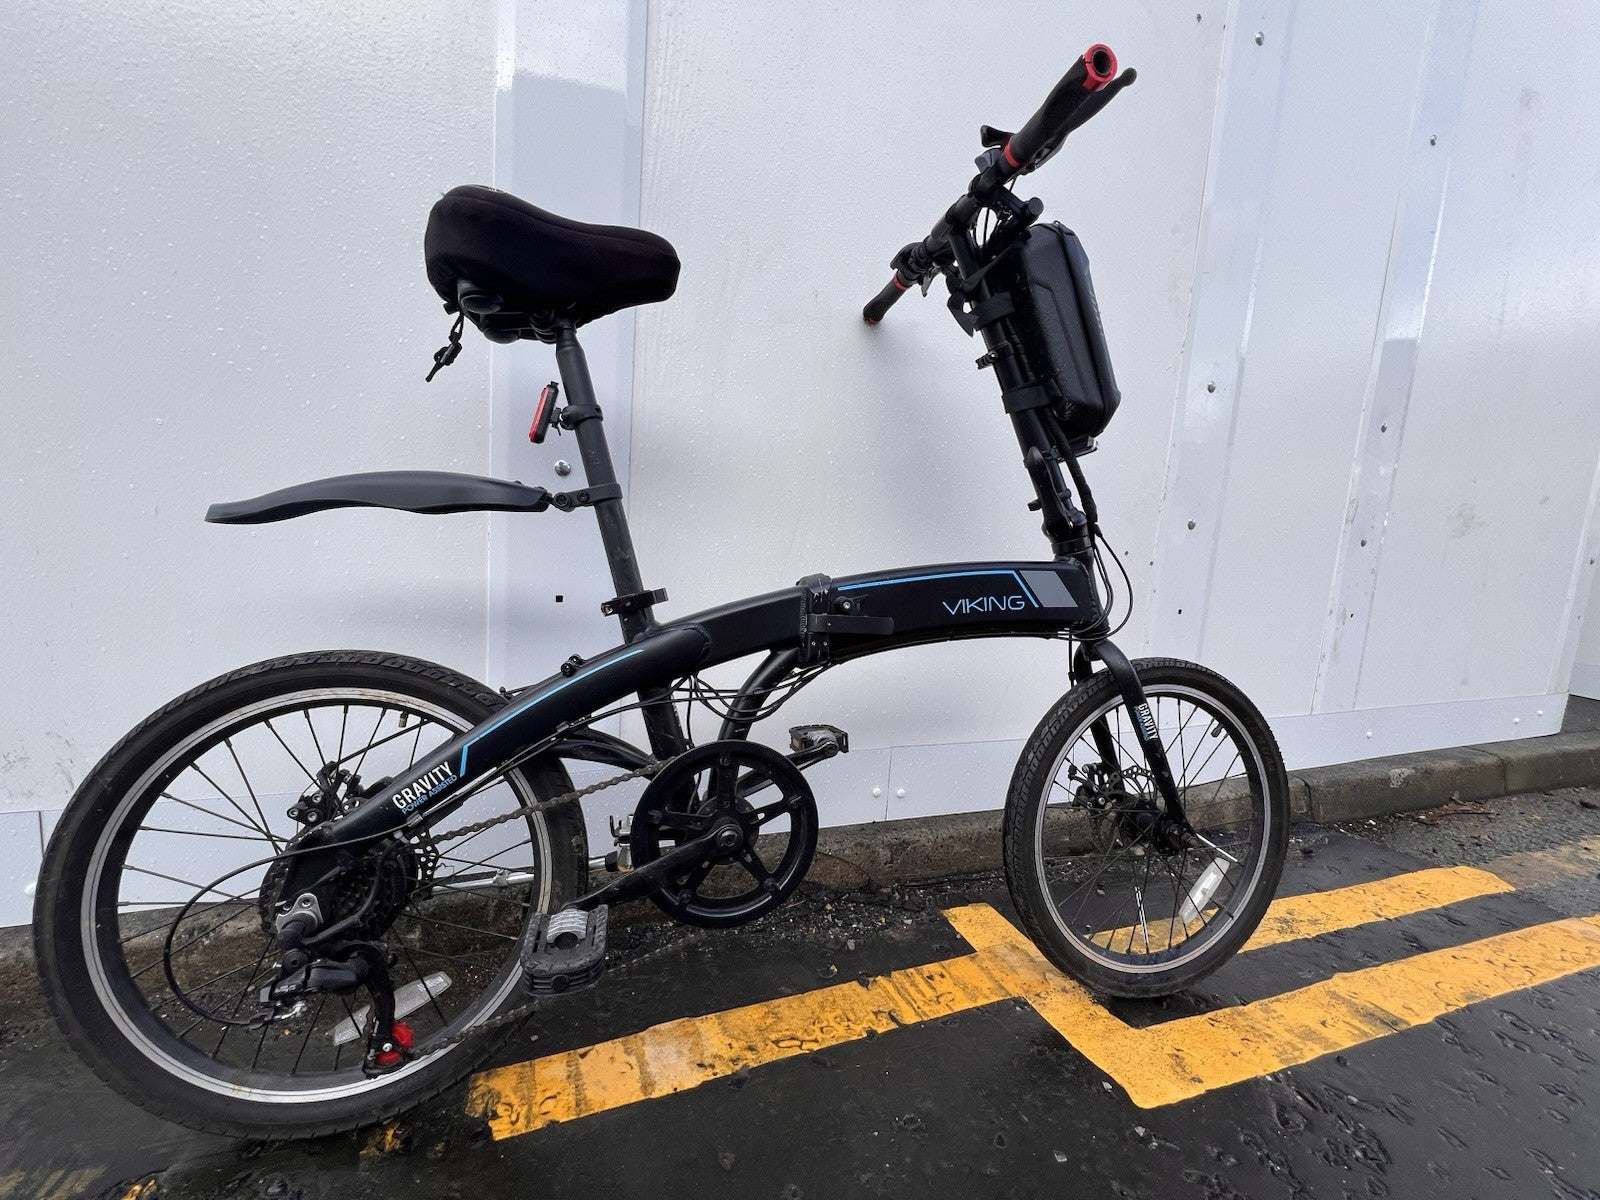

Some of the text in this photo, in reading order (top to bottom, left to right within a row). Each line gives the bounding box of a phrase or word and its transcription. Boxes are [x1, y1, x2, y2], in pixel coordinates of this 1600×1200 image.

[942, 595, 1026, 615] VIKING
[1138, 703, 1159, 740] GRAVITY
[392, 761, 453, 809] GRAVITY
[401, 774, 458, 815] POWER ASSISTED
